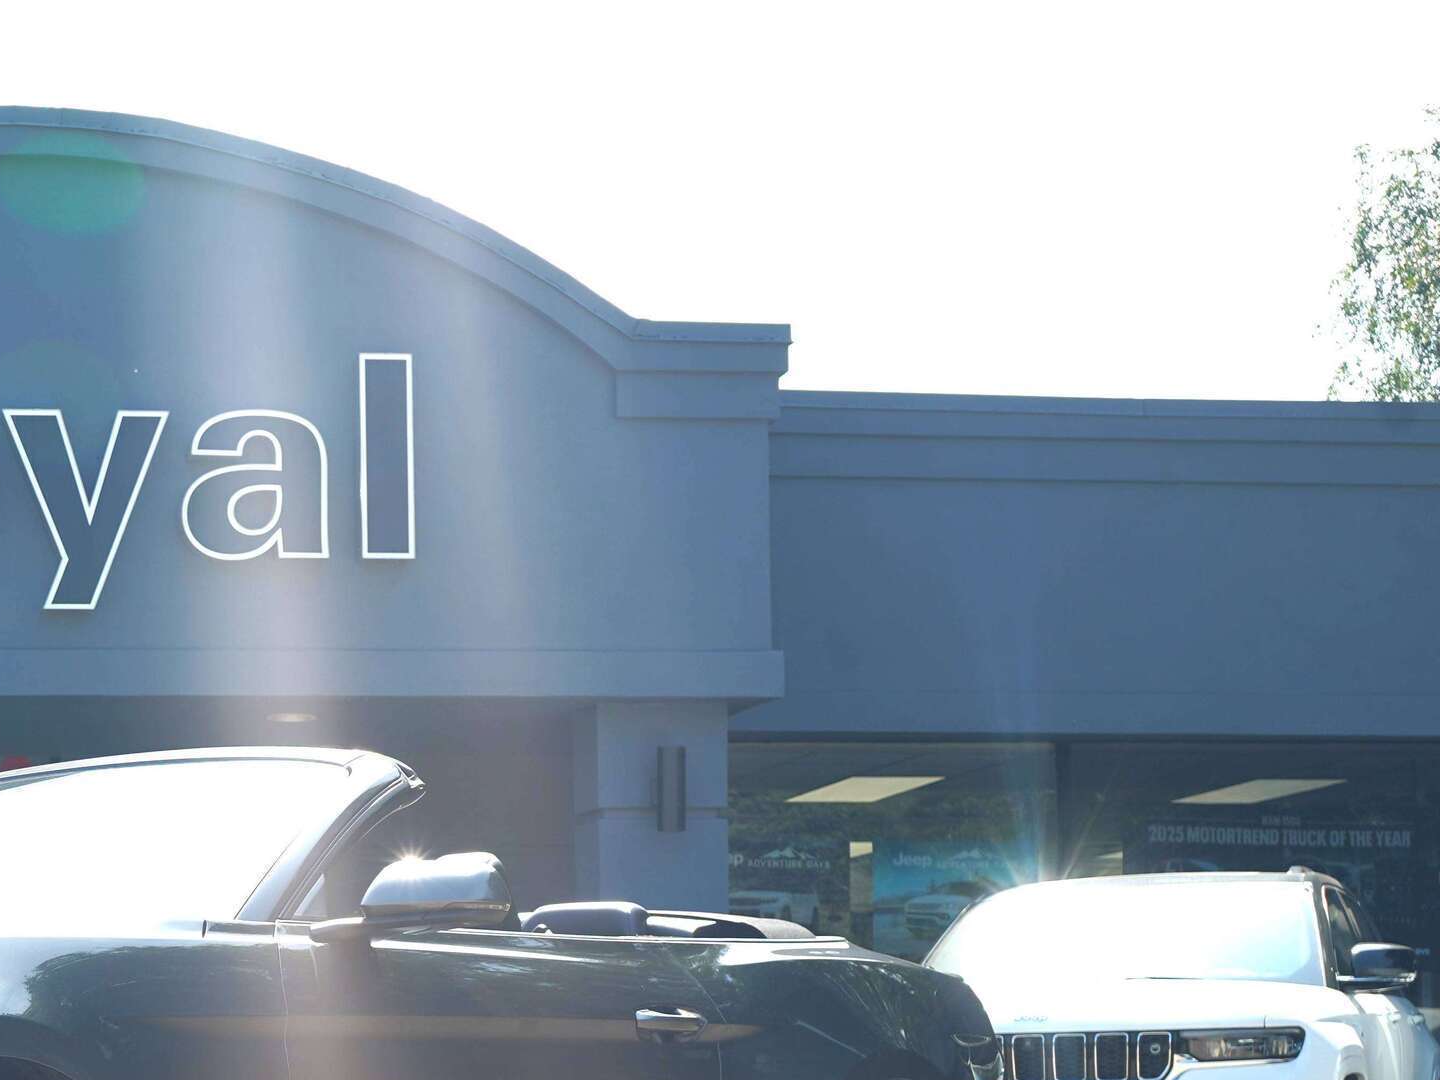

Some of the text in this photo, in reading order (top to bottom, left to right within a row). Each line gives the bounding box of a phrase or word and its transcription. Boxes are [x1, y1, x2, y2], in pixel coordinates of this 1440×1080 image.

[1148, 824, 1411, 848] 2025 MOTORTREND TRUCK OF THE YEAR
[893, 850, 932, 868] Jeep
